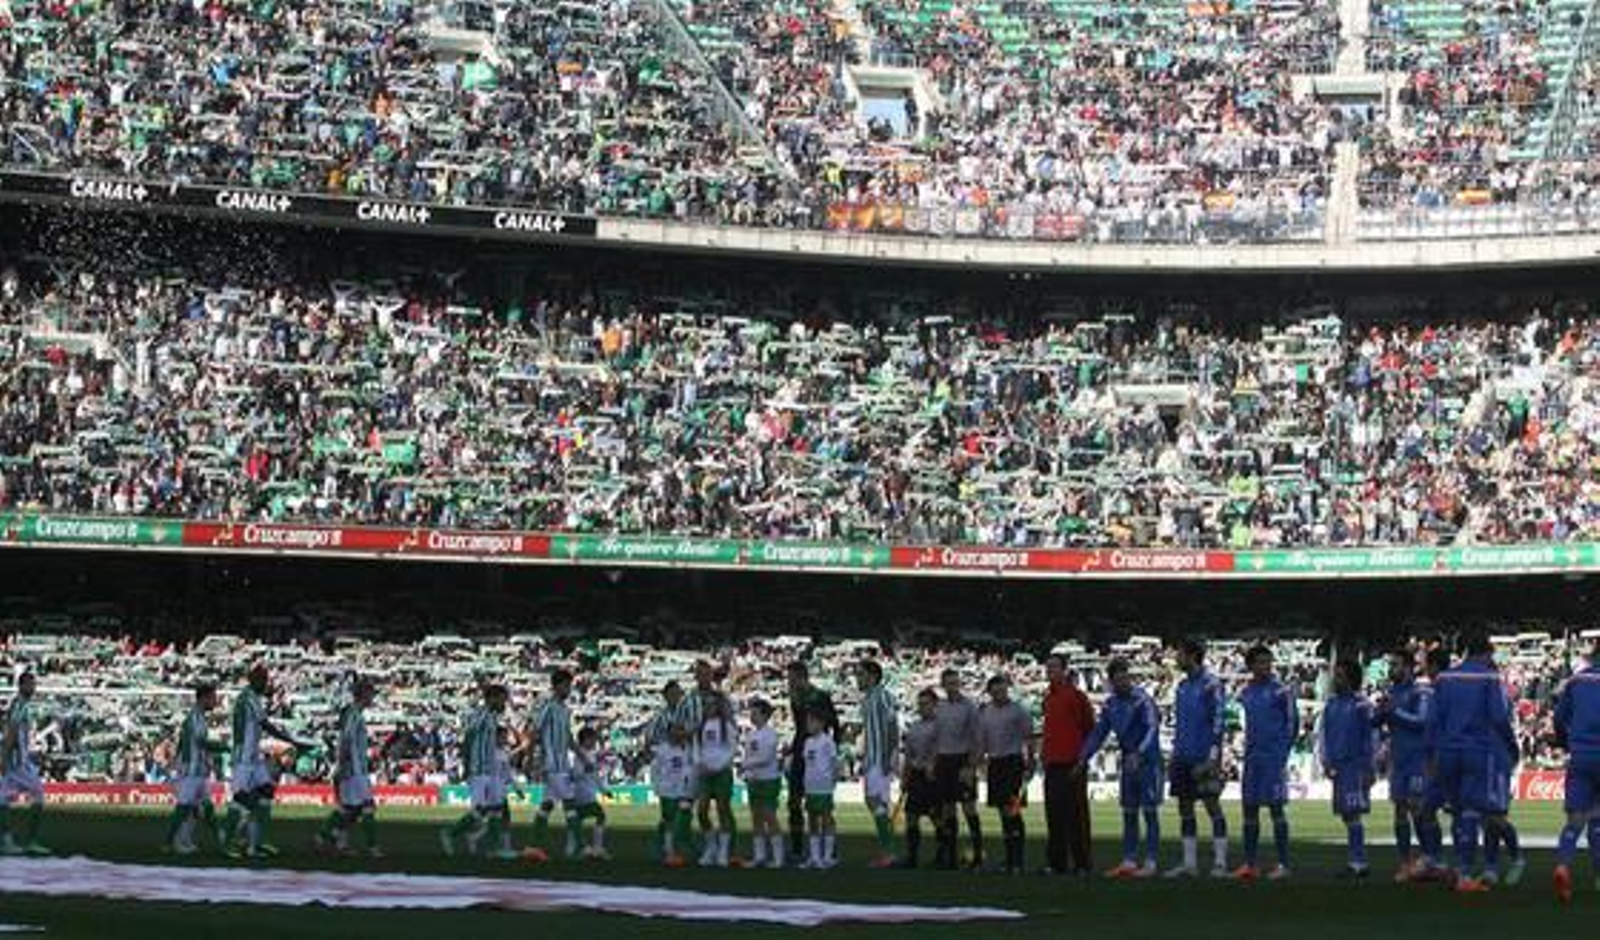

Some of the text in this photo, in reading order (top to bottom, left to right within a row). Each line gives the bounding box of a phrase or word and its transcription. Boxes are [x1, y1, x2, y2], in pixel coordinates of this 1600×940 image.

[70, 179, 148, 201] CANAL+
[215, 191, 291, 212] CANAL+
[356, 202, 431, 224] CANAL+
[494, 212, 566, 233] CANAL+
[35, 517, 124, 540] Cruzcampo
[243, 524, 329, 547] Cruzcampo
[427, 530, 512, 553] Cruzcampo
[763, 542, 840, 564] Cruzcampo
[940, 547, 1016, 568] Cruzcampo
[1109, 550, 1195, 570] Cruzcampo
